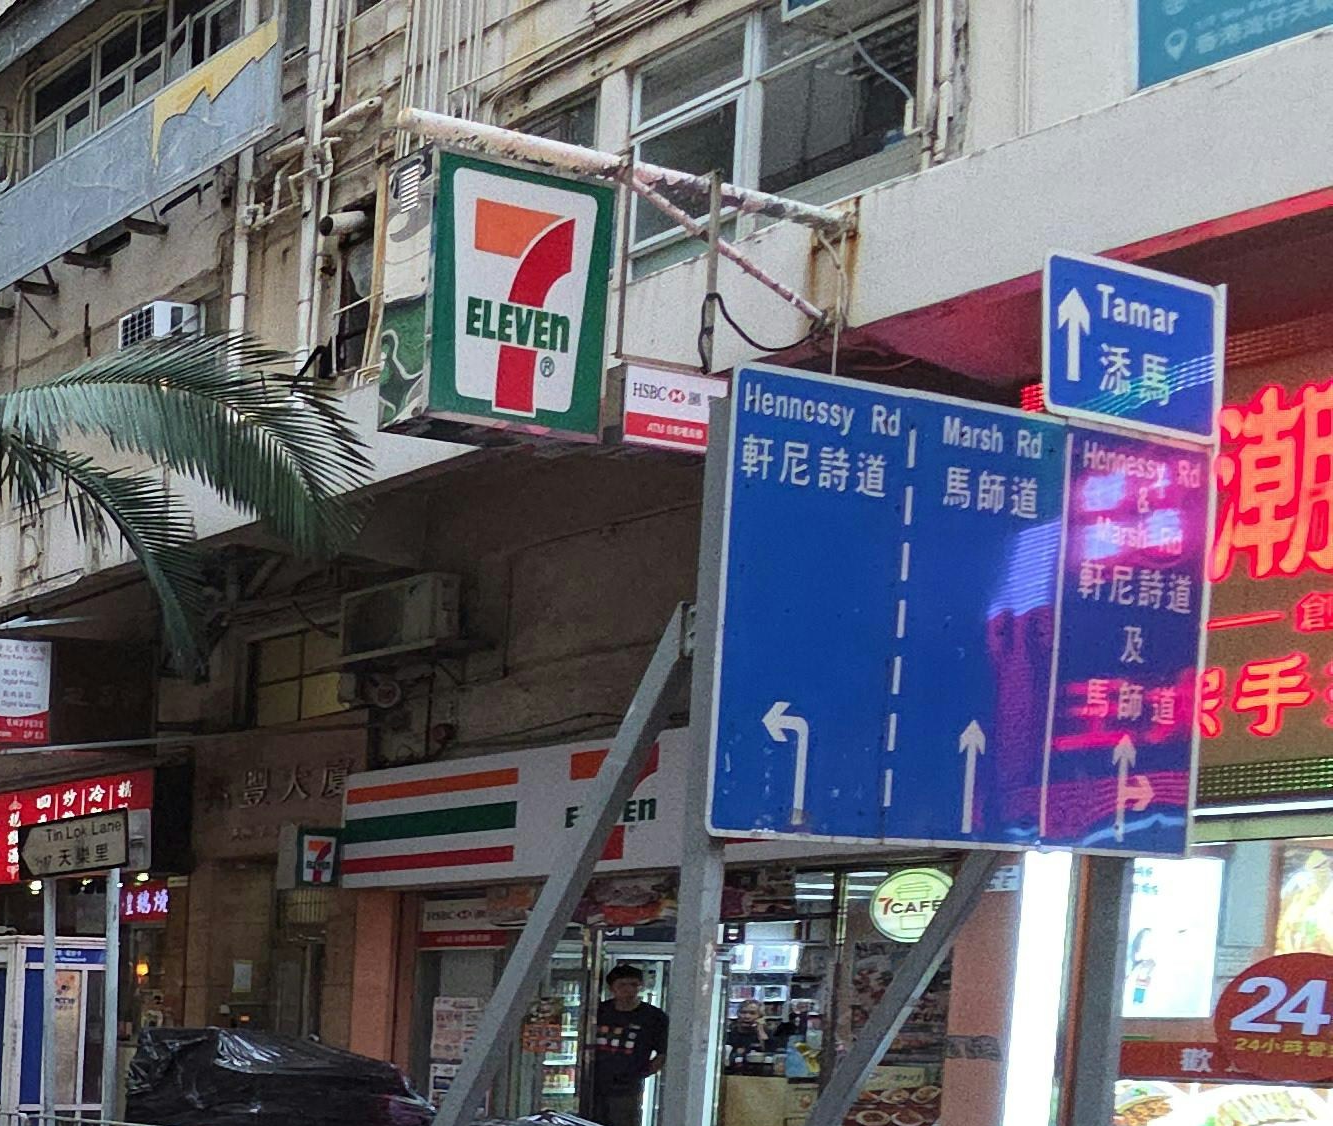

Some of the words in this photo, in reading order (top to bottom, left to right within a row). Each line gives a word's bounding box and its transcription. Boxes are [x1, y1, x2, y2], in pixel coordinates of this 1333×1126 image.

[1096, 283, 1179, 336] Tamar
[633, 382, 667, 401] HSBC
[1099, 343, 1171, 407] 添馬
[744, 381, 855, 437] Hennessy
[871, 404, 901, 437] Rd
[943, 415, 1004, 454] Marsh
[1017, 429, 1042, 460] Rd
[740, 433, 887, 498] 軒尼詩道
[1082, 440, 1167, 487] Hennessy
[1178, 458, 1202, 490] Rd
[943, 466, 1039, 519] 馬師道
[1136, 487, 1150, 513] &
[1096, 515, 1148, 549] Marsh
[1077, 562, 1193, 615] 軒尼詩道
[1119, 625, 1145, 664] 及
[1082, 678, 1177, 725] 馬師道
[46, 829, 63, 842] Tin
[66, 822, 86, 840] Lok
[91, 818, 122, 836] Lane
[58, 843, 110, 867] 天樂里
[1230, 976, 1332, 1036] 24
